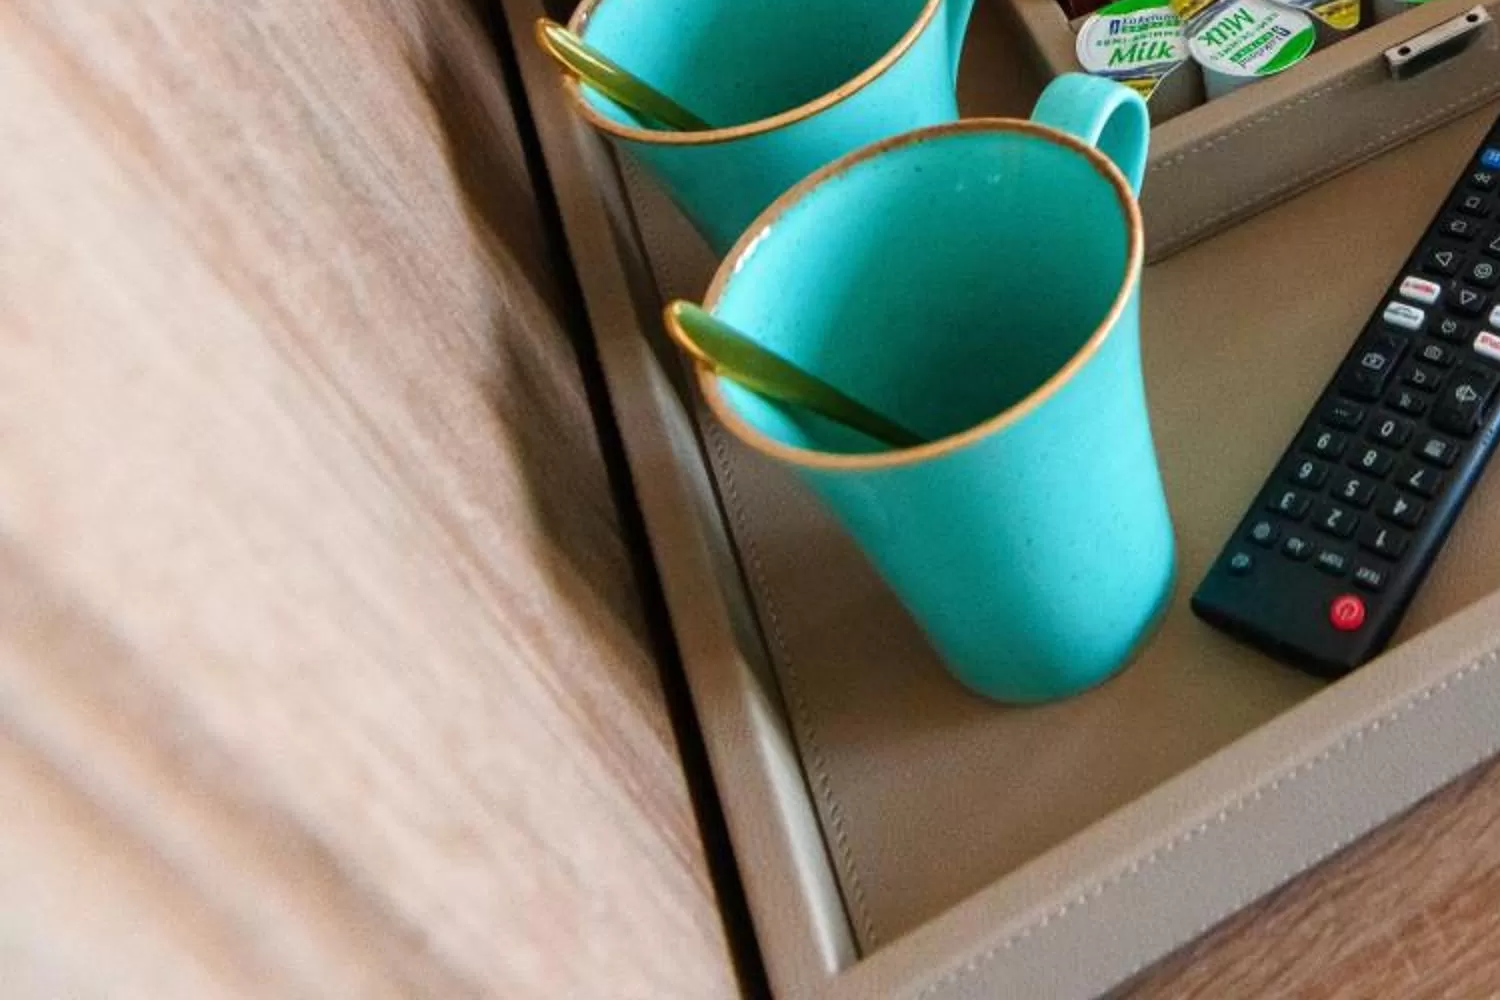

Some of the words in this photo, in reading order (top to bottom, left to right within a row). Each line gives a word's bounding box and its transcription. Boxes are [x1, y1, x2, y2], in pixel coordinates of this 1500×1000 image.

[1198, 6, 1256, 47] Milk
[1108, 40, 1176, 67] Milk
[1380, 420, 1396, 438] 0
[1316, 432, 1332, 450] 9
[1362, 449, 1378, 468] 8
[1298, 461, 1313, 479] 6
[1409, 469, 1425, 487] 7
[1344, 479, 1361, 498] 5
[1279, 491, 1296, 510] 3
[1392, 499, 1409, 516] 4
[1326, 507, 1343, 528] 2
[1375, 529, 1388, 548] 1
